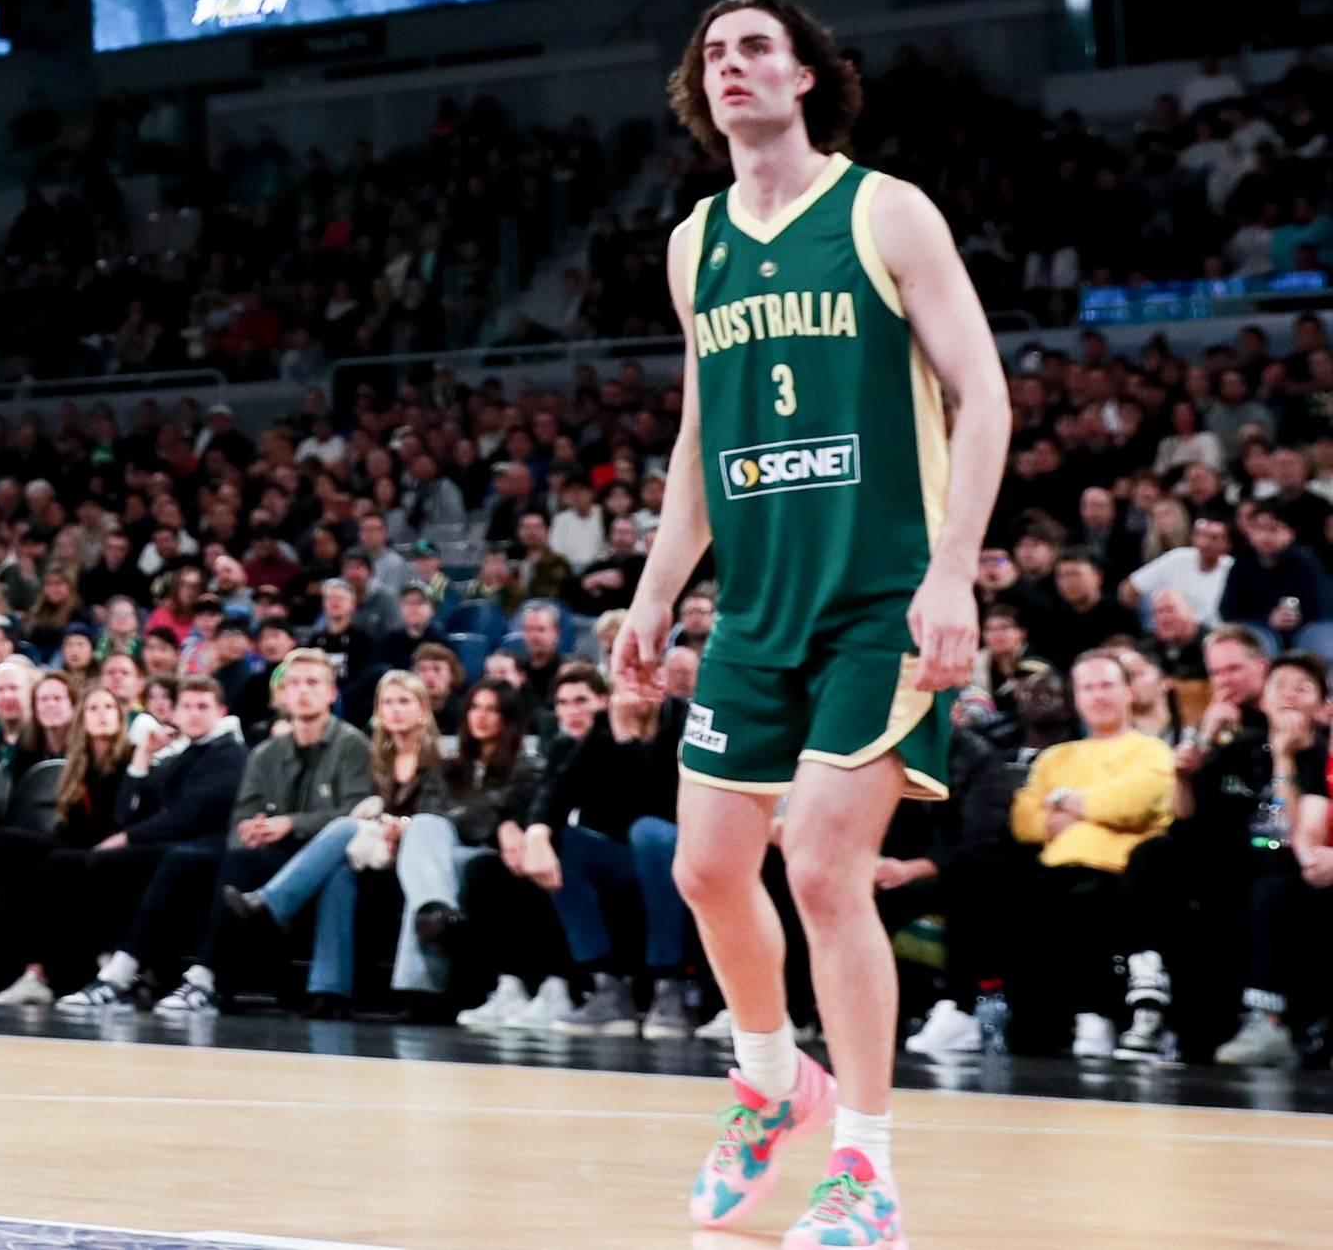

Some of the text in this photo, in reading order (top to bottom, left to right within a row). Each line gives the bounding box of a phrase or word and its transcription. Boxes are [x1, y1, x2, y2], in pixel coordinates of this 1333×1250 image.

[694, 291, 858, 358] AUSTRALIA
[770, 363, 798, 418] 3
[757, 444, 853, 486] SIGNET
